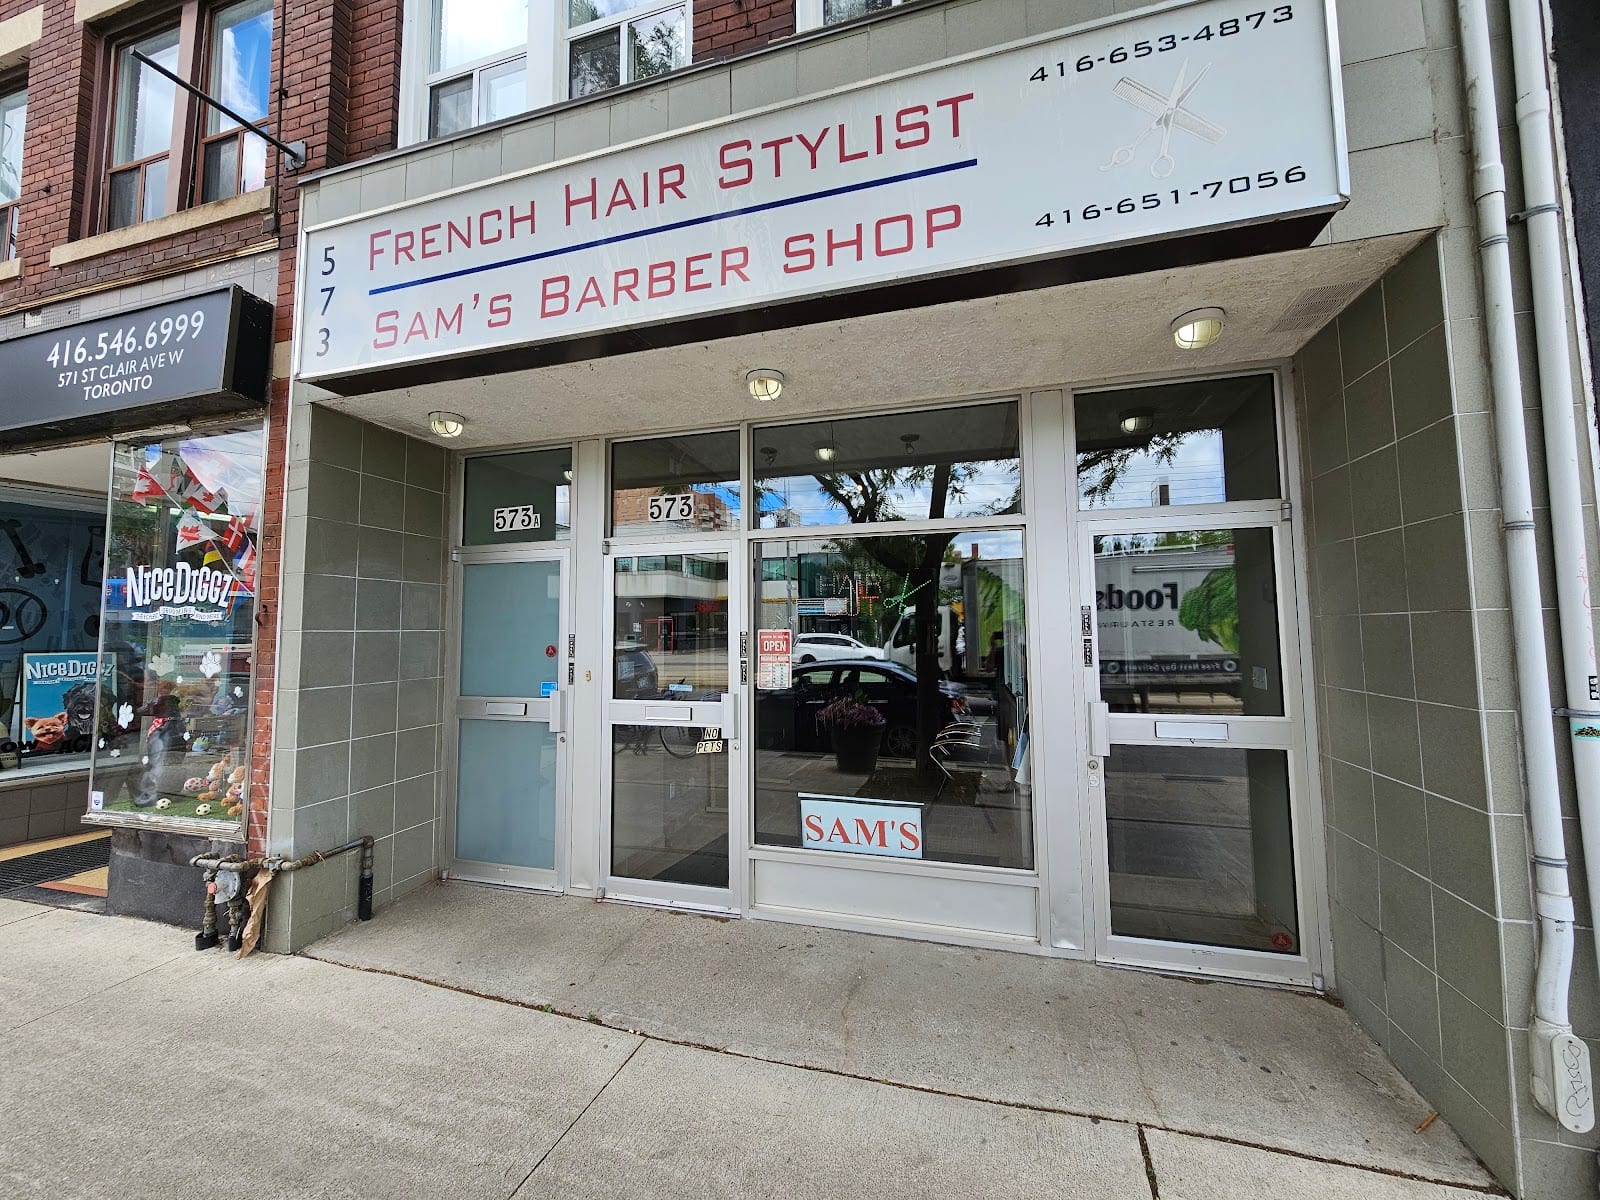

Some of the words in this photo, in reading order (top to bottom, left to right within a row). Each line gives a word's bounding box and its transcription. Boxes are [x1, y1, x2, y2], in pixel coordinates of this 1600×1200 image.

[1029, 5, 1294, 82] 416-653-4873
[369, 200, 536, 271] FRENCH
[564, 163, 687, 226] HAIR
[718, 92, 974, 190] STYLIST
[1034, 165, 1307, 228] 416-651-7056
[372, 293, 513, 349] SAM'S
[540, 246, 751, 319] BARBER
[783, 204, 962, 274] SHOP
[46, 310, 205, 369] 416.546.6999
[57, 371, 78, 388] 571
[81, 367, 98, 383] ST
[99, 359, 137, 380] CLAIR
[139, 353, 166, 372] AVE
[168, 349, 185, 365] W
[83, 375, 153, 401] TORONTO
[650, 496, 693, 519] 573
[763, 640, 787, 651] OPEN
[697, 741, 722, 753] PETS
[704, 728, 718, 739] NO
[805, 815, 920, 851] SAM'S
